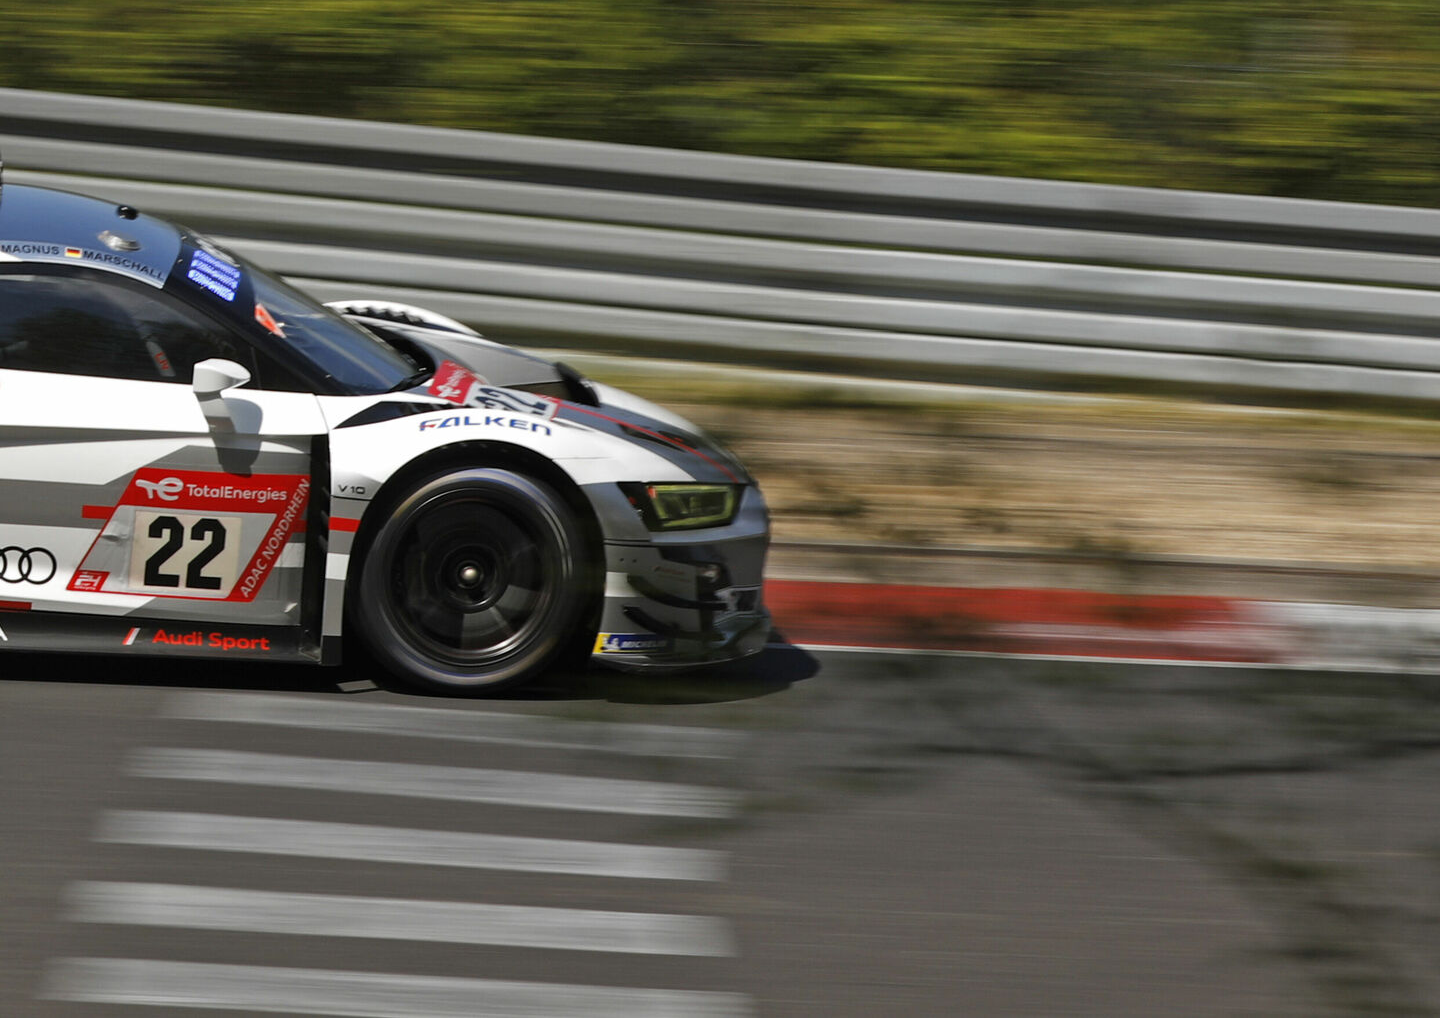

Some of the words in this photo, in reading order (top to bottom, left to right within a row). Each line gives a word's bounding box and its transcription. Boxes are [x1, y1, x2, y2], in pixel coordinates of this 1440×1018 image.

[1, 244, 60, 256] MAGNUS
[83, 249, 165, 282] MARSCHALL
[419, 416, 552, 436] FALKEN
[186, 484, 288, 504] TotalEnergies
[240, 558, 268, 598] ADAC
[264, 478, 311, 561] NORDRHEIN
[144, 515, 227, 590] 22
[152, 629, 204, 647] Audi
[207, 632, 271, 651] Sport
